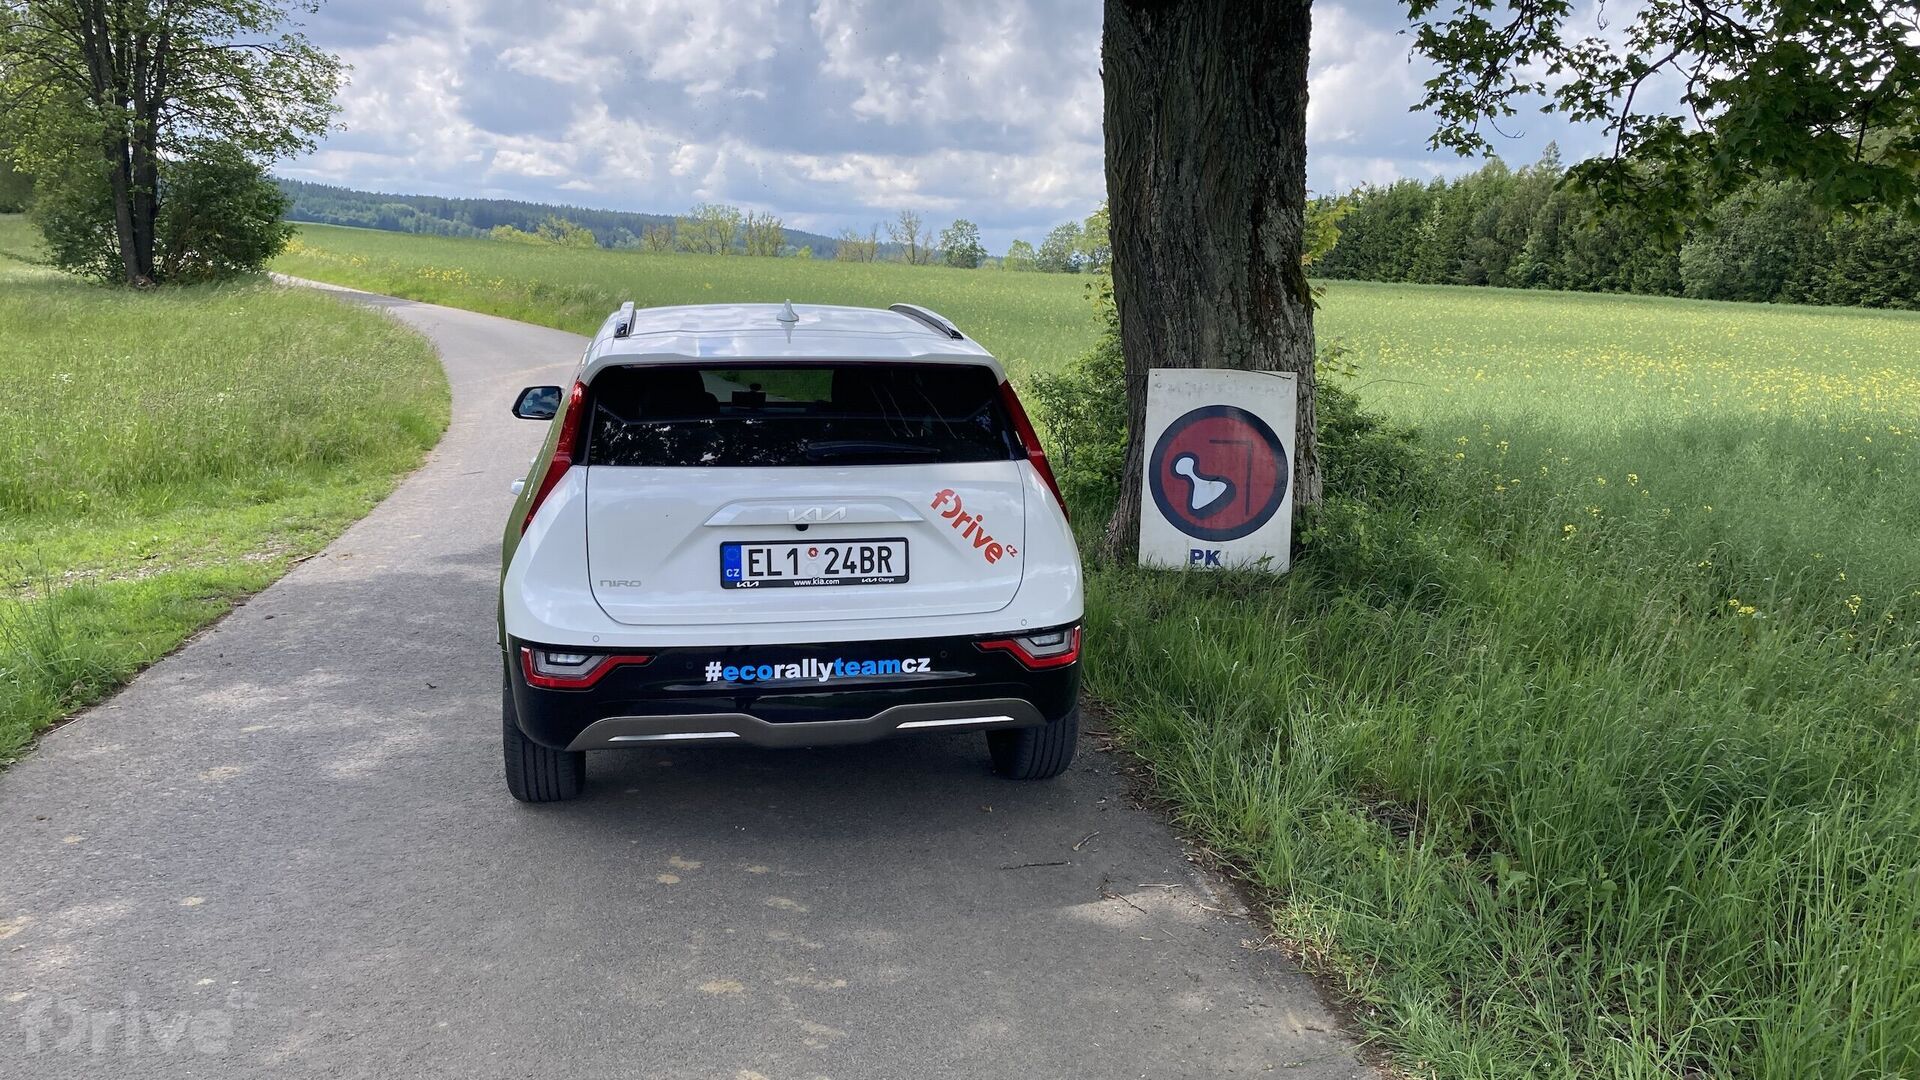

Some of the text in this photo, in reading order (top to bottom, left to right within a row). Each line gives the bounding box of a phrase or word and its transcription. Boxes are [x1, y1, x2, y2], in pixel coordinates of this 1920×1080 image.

[748, 545, 893, 577] EL1 24BR
[1189, 548, 1221, 566] PK
[726, 568, 740, 578] CZ
[793, 576, 840, 586] www.kia.com
[705, 657, 931, 682] #ecorallyteamcz
